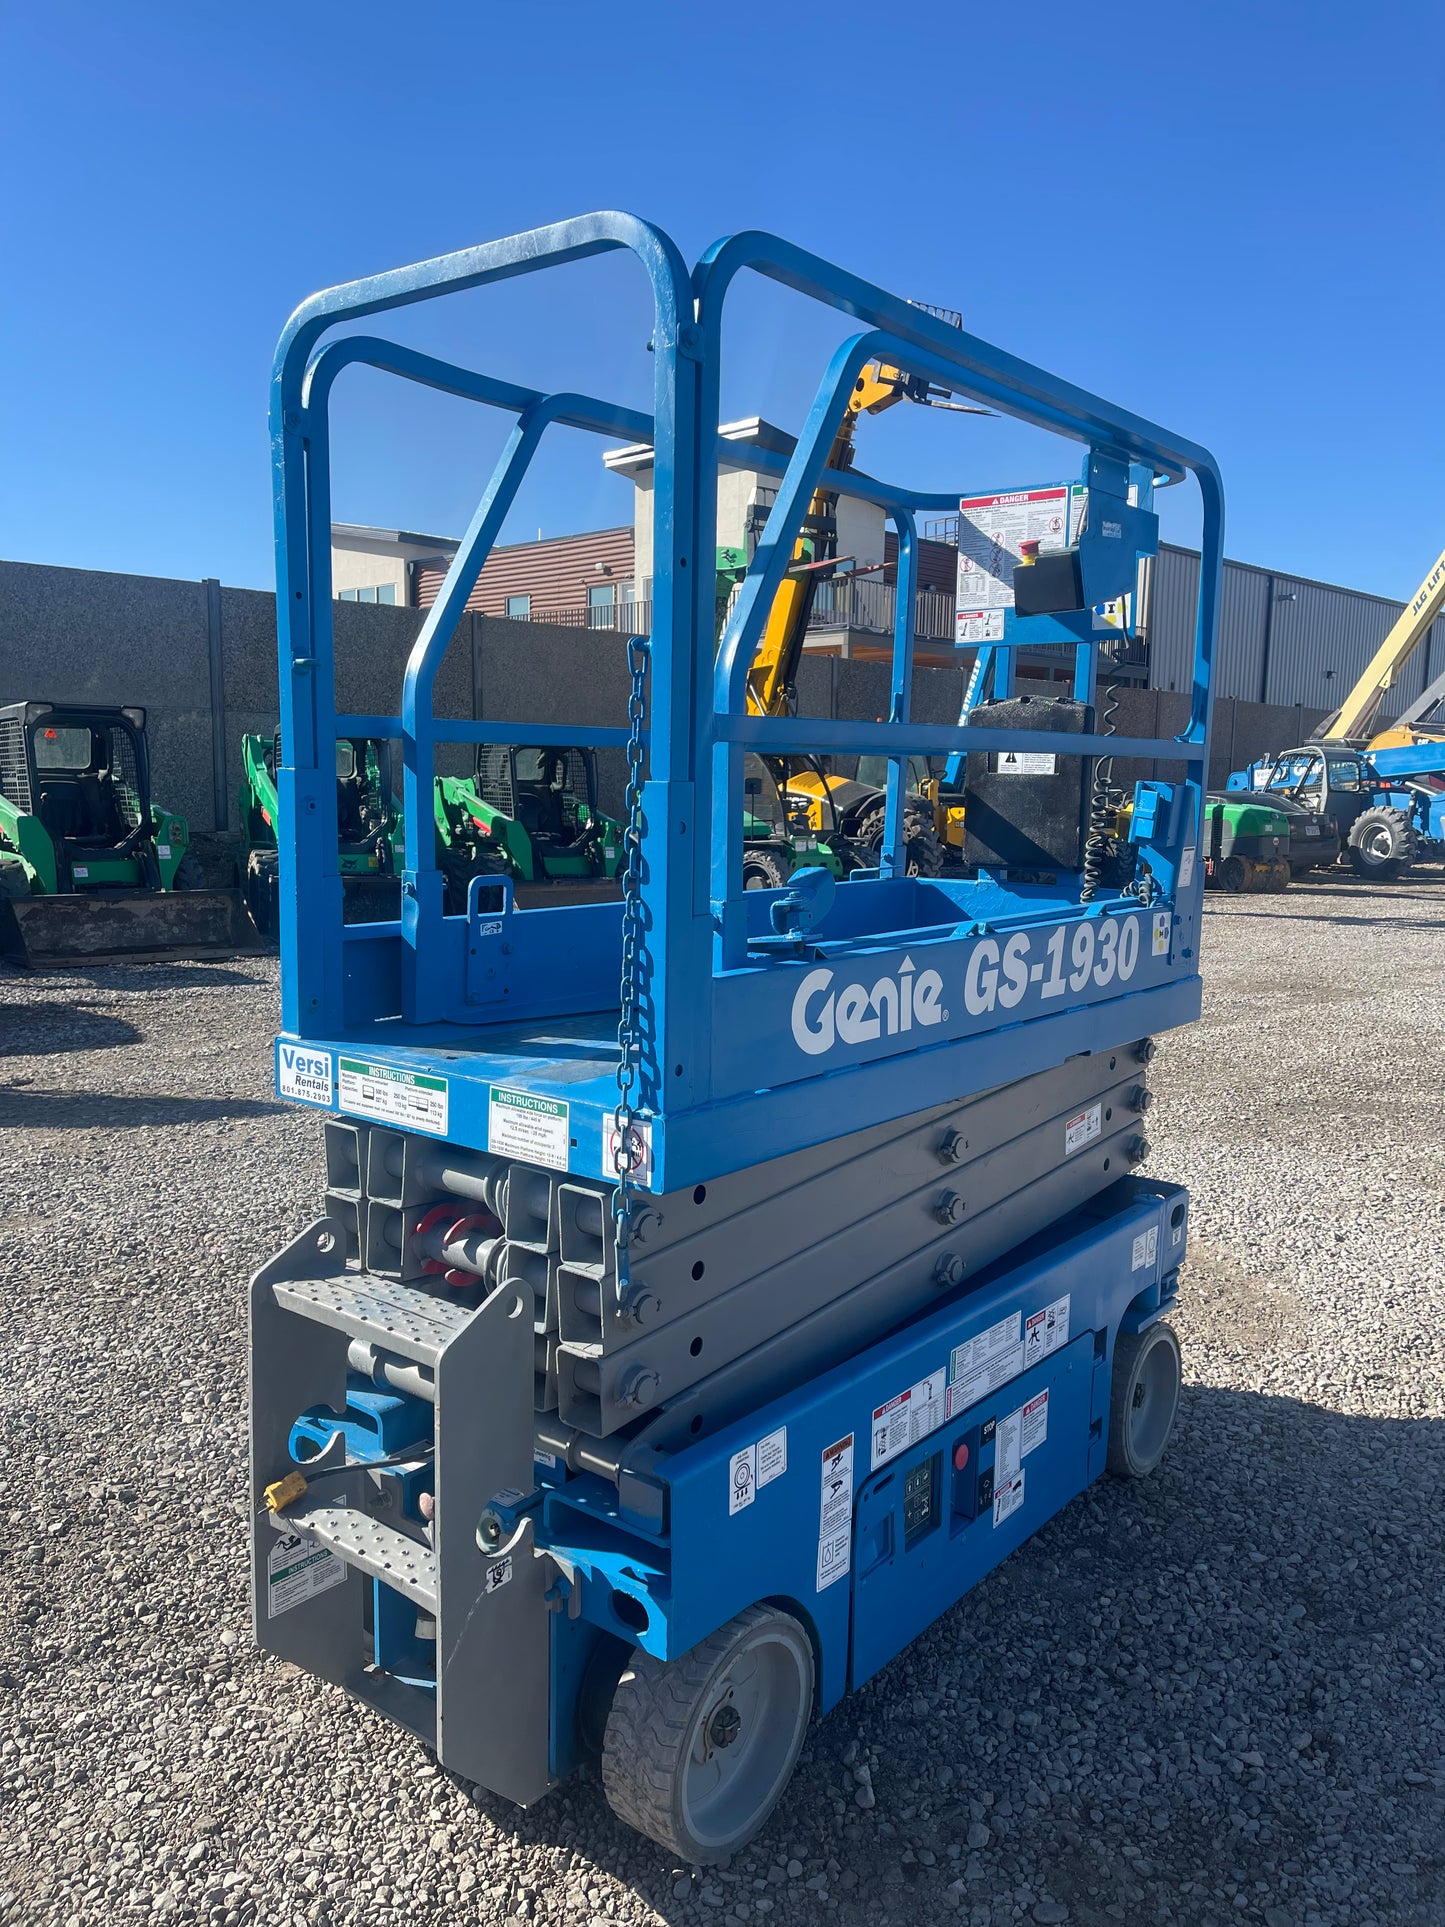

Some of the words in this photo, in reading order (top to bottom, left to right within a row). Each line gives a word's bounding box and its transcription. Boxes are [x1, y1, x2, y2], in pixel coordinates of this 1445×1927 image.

[1000, 494, 1029, 504] DANGER
[1412, 590, 1428, 617] JLG
[791, 955, 944, 1055] Genie
[964, 915, 1140, 1016] GS-1930
[282, 1048, 329, 1078] Versi
[295, 1075, 329, 1092] Rentals
[368, 1066, 415, 1085] INSTRUCTIONS
[281, 1085, 331, 1103] 801.875.2903
[498, 1091, 558, 1114] INSTRUCTIONS
[1031, 1311, 1045, 1326] DANGER
[885, 1396, 902, 1411] DANGER
[1030, 1394, 1047, 1412] DANGER
[983, 1420, 996, 1435] STOP
[288, 1550, 328, 1574] INSTRUCTIONS
